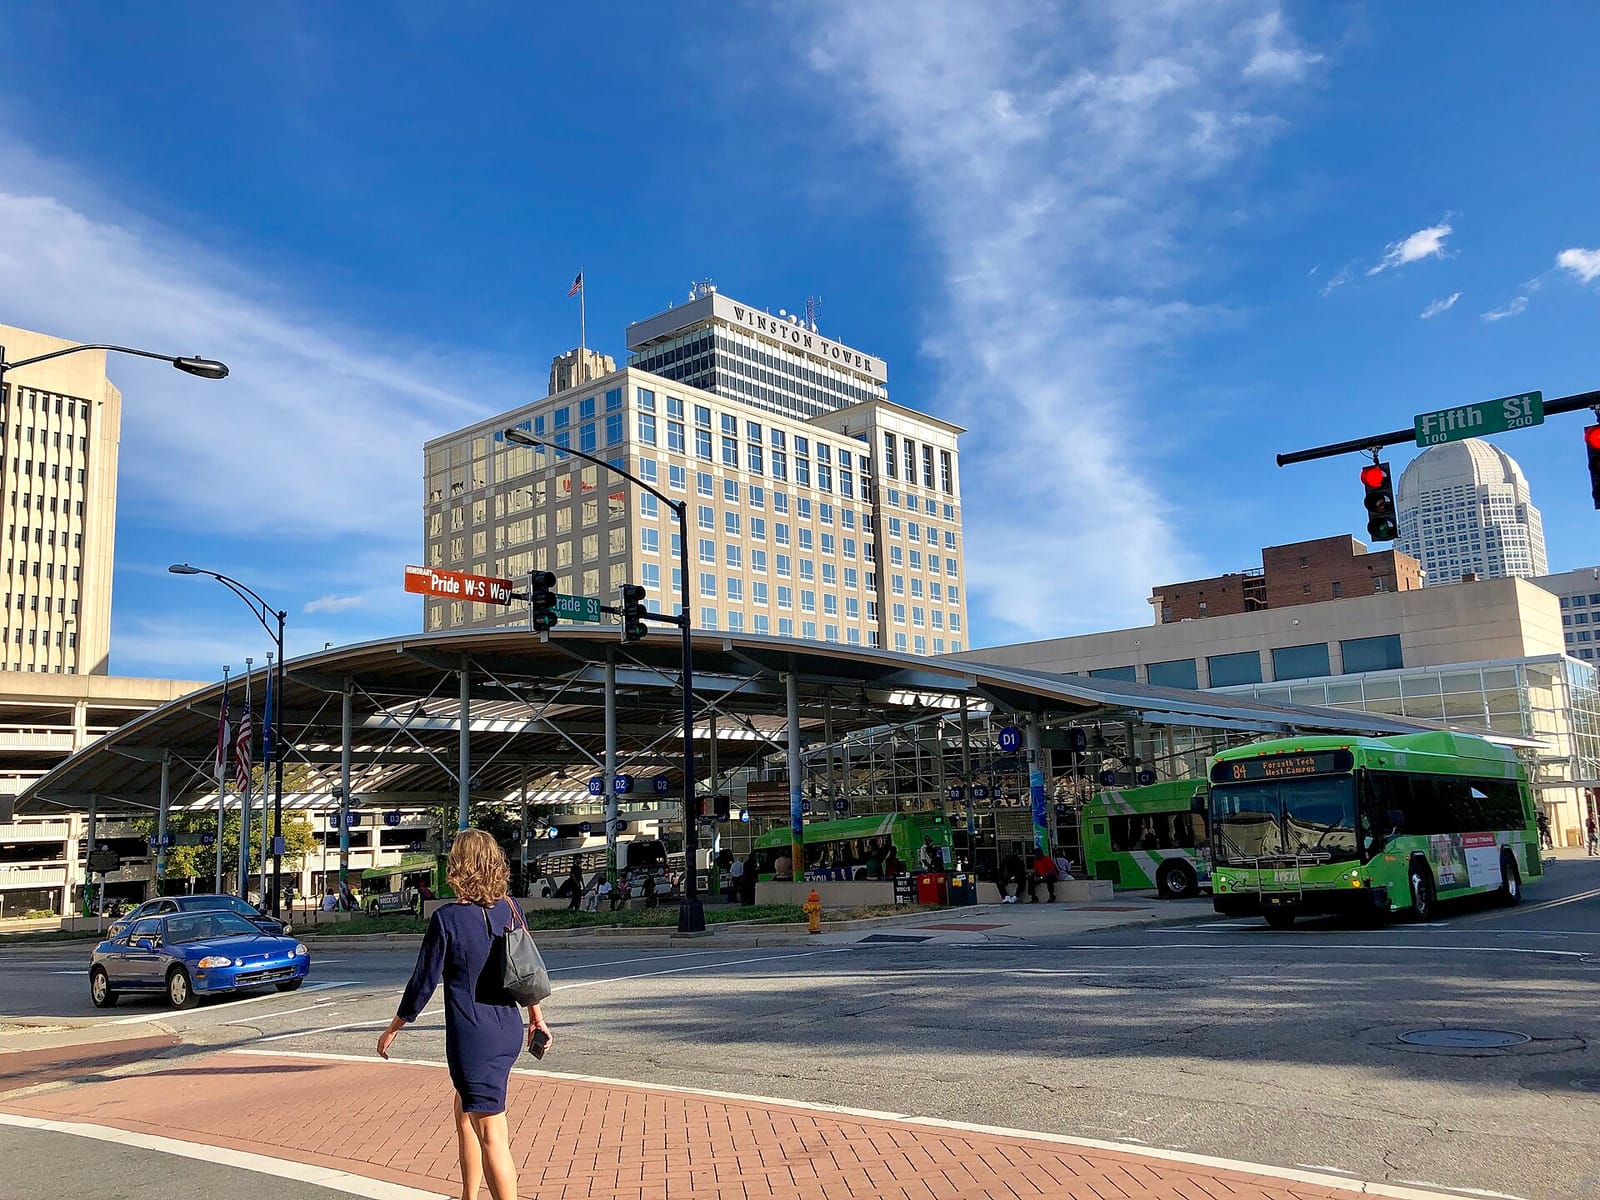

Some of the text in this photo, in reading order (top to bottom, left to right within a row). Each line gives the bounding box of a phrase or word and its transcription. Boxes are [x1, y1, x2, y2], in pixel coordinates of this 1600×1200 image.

[733, 306, 872, 372] WINSTON TOWER
[1421, 396, 1533, 436] Fifth St
[1507, 416, 1533, 429] 200
[1424, 432, 1448, 444] 100
[431, 574, 511, 604] Pride W-S Way
[554, 595, 598, 614] rade St
[1003, 733, 1015, 745] D1
[1296, 757, 1315, 766] Tech
[1265, 768, 1284, 776] West
[590, 782, 600, 791] D2
[615, 779, 625, 789] D2
[657, 780, 667, 790] D2
[950, 789, 960, 798] B2
[973, 788, 984, 797] B2
[836, 801, 844, 809] C2
[346, 815, 354, 824] D3
[389, 815, 399, 823] D3
